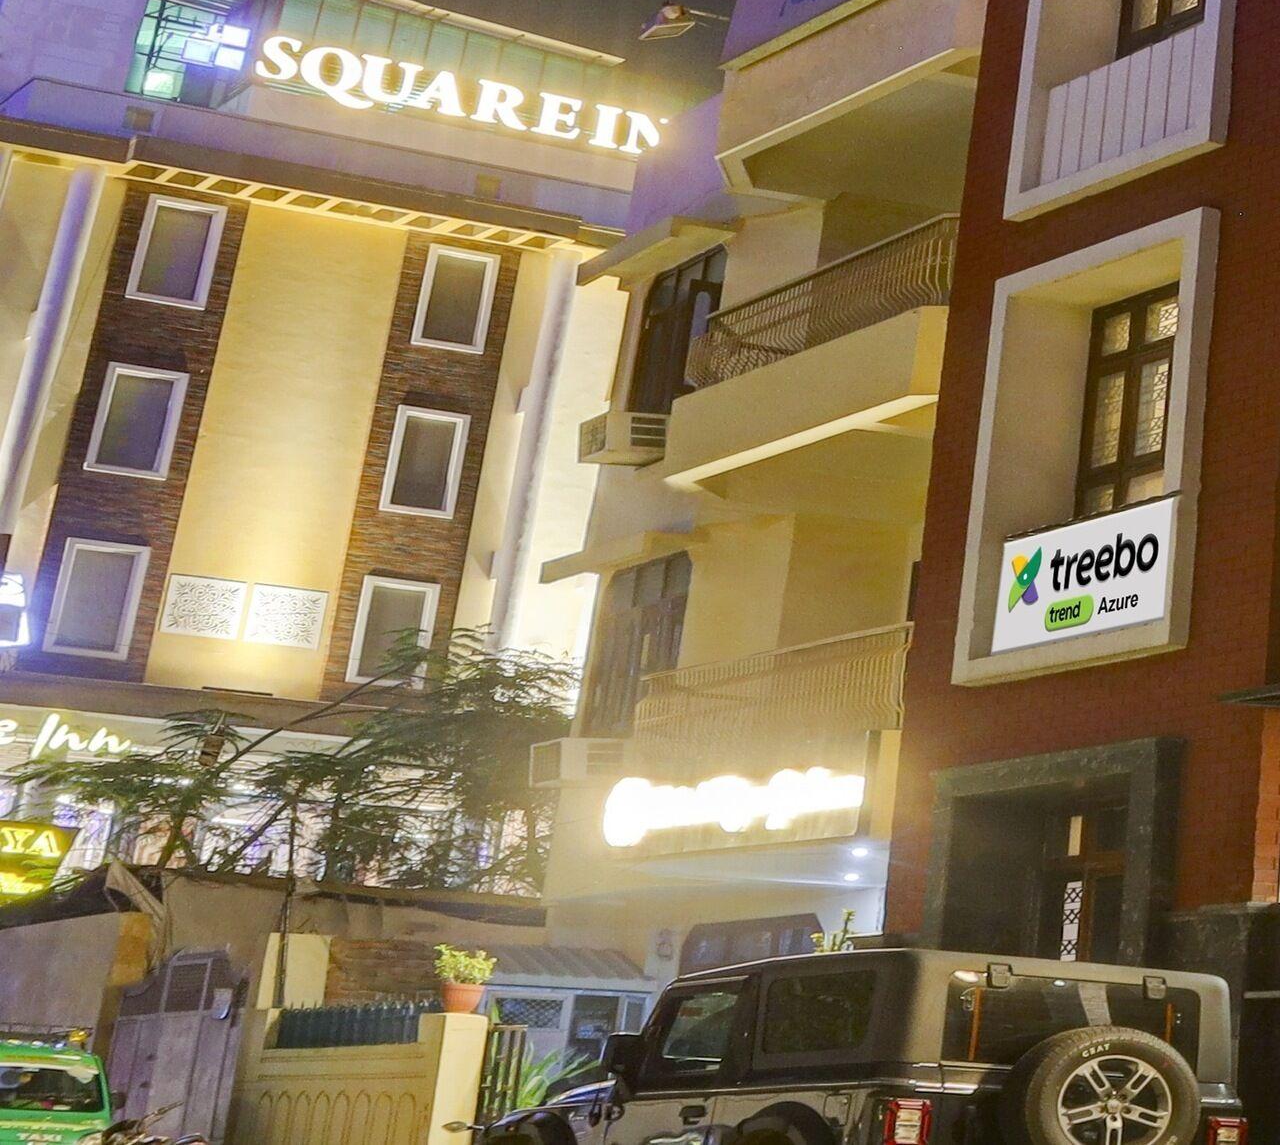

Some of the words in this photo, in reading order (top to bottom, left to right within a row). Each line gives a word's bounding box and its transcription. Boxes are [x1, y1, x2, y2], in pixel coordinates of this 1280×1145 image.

[1050, 532, 1159, 592] treebo
[1049, 601, 1081, 623] trend
[1097, 593, 1139, 615] Azure
[30, 713, 131, 759] Inn
[1082, 1043, 1110, 1058] CEAT
